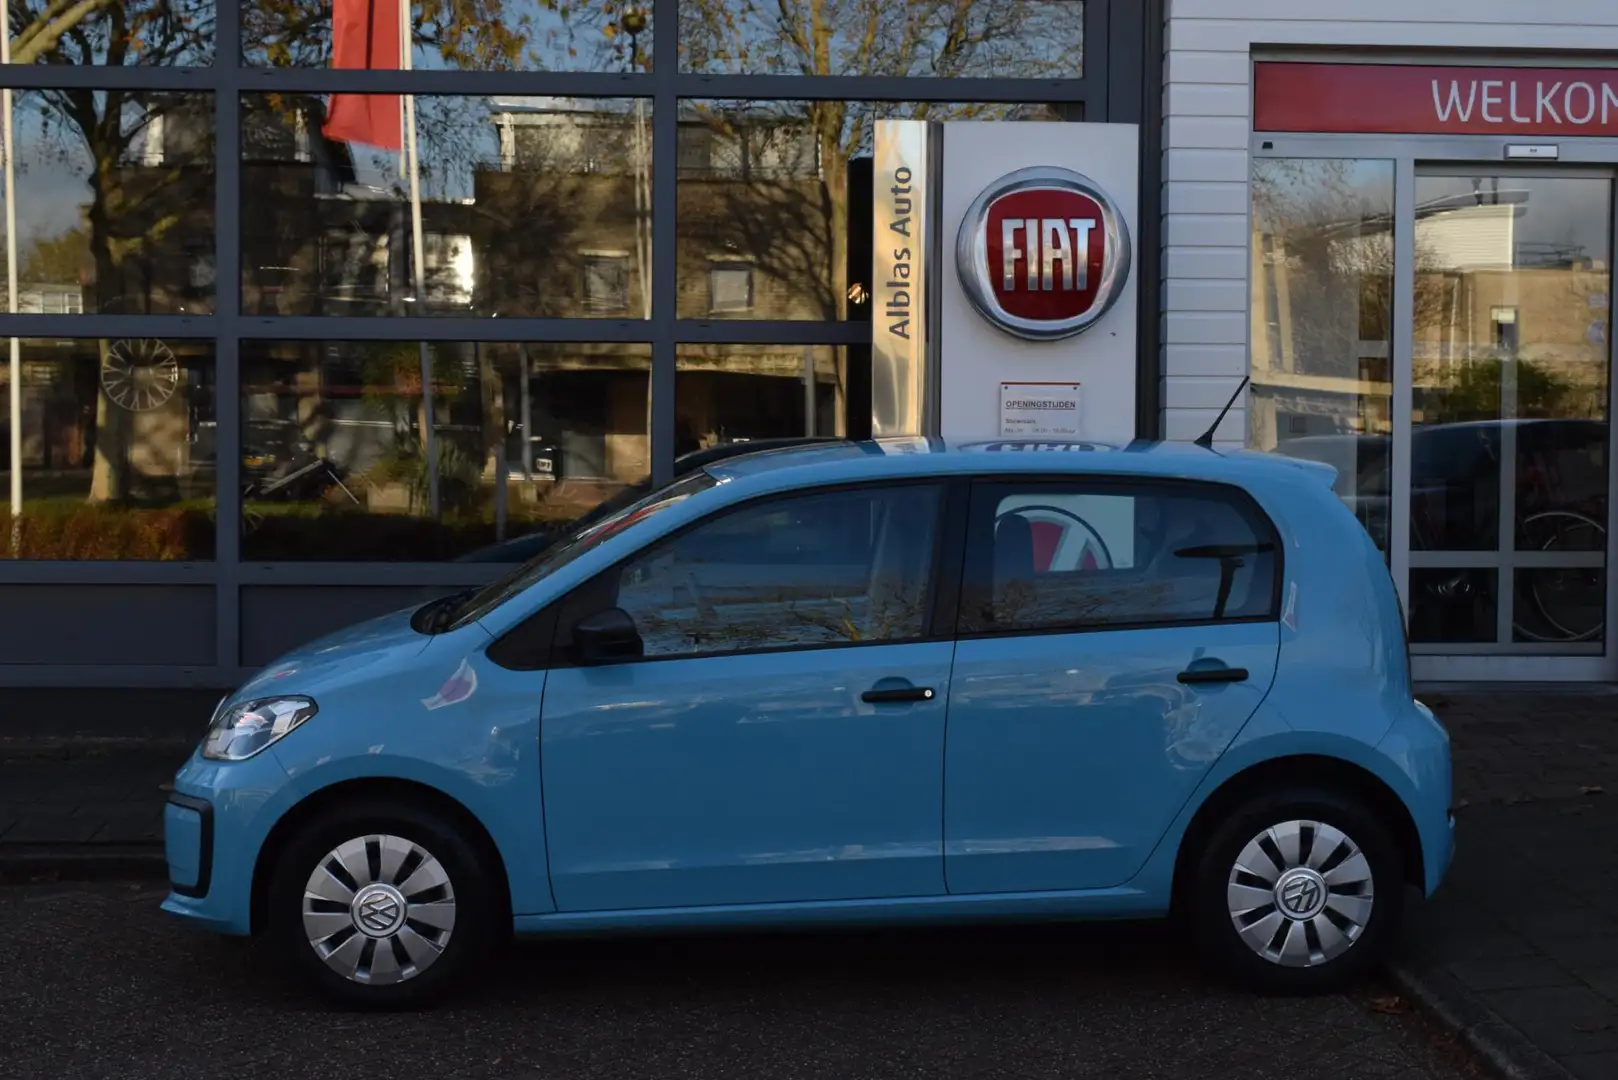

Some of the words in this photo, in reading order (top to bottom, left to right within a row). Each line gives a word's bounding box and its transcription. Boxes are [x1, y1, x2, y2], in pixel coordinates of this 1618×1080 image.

[889, 166, 912, 238] Auto
[1001, 218, 1096, 291] FIAT
[886, 247, 912, 341] Alblas
[1005, 400, 1076, 409] OPENINGSTIJDEN
